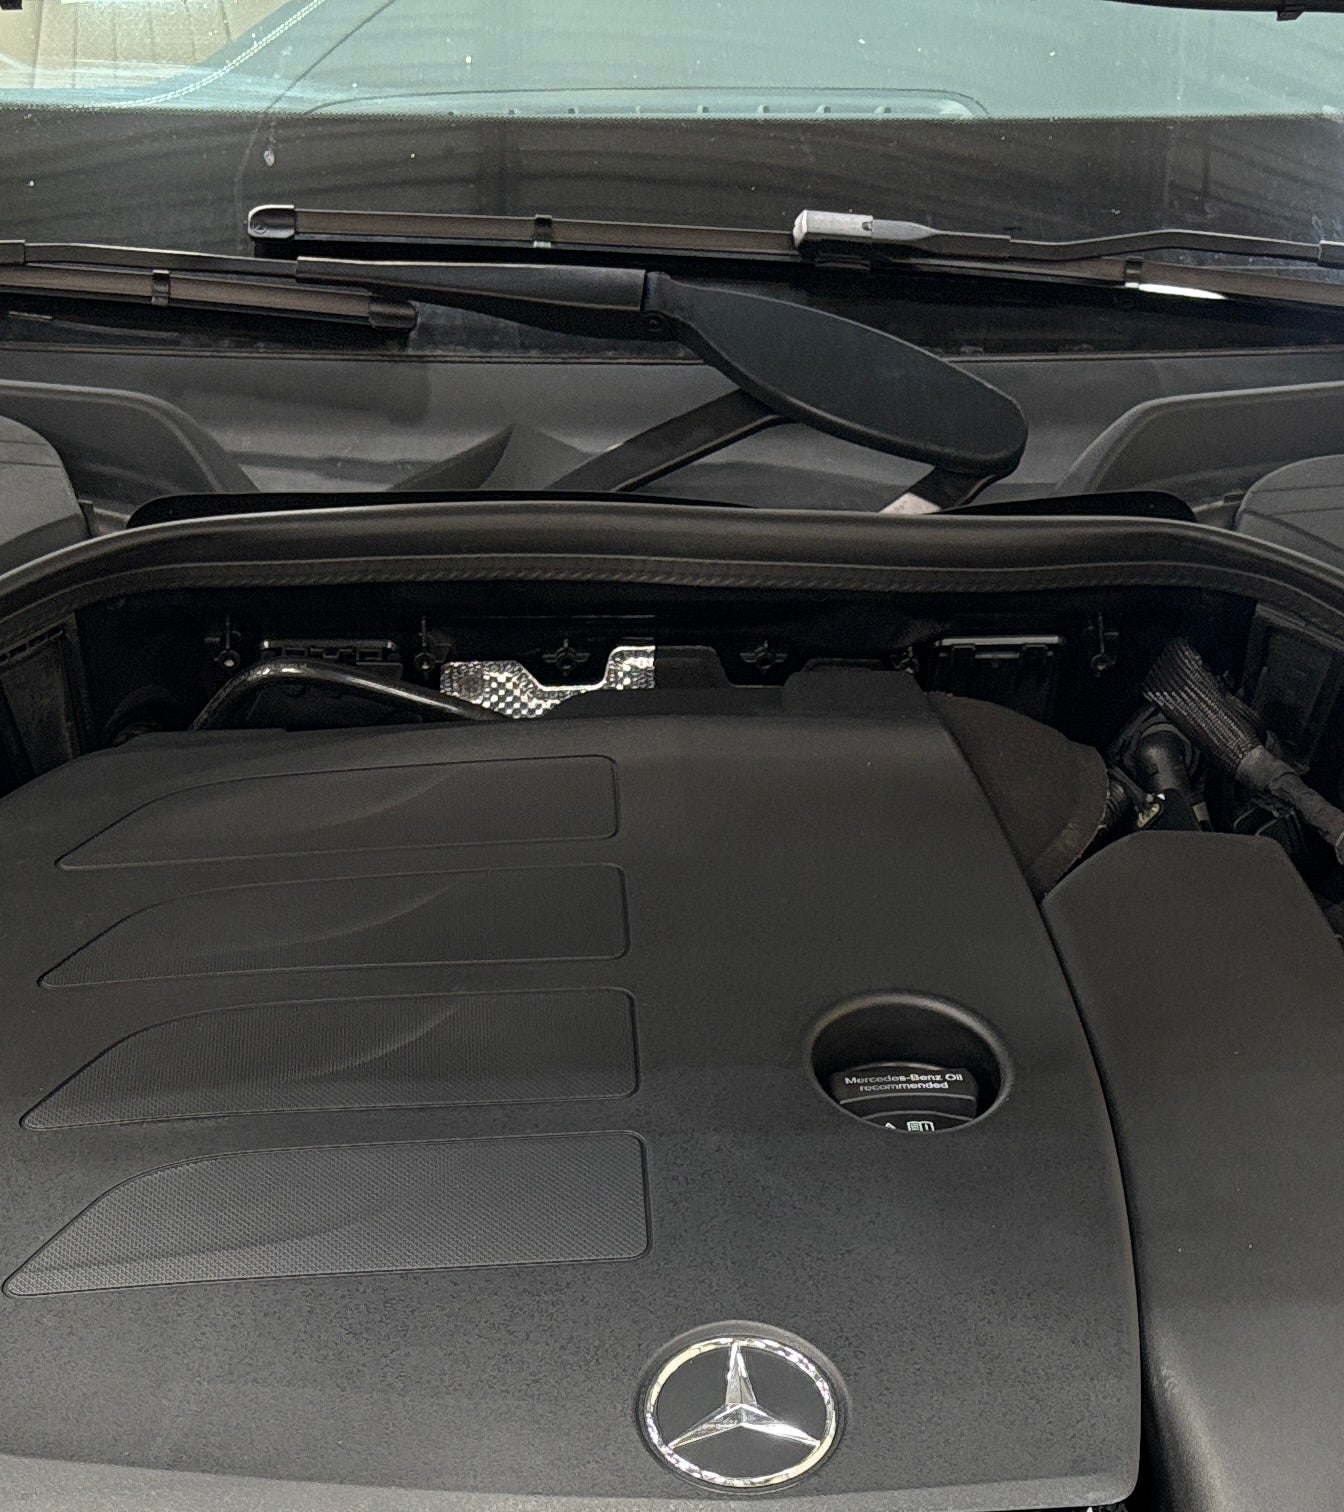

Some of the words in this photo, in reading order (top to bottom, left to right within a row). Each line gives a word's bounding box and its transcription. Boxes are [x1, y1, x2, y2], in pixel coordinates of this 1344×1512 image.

[844, 1073, 943, 1085] Mercedes-Benz
[945, 1073, 964, 1082] Oil
[859, 1081, 949, 1092] recommended
